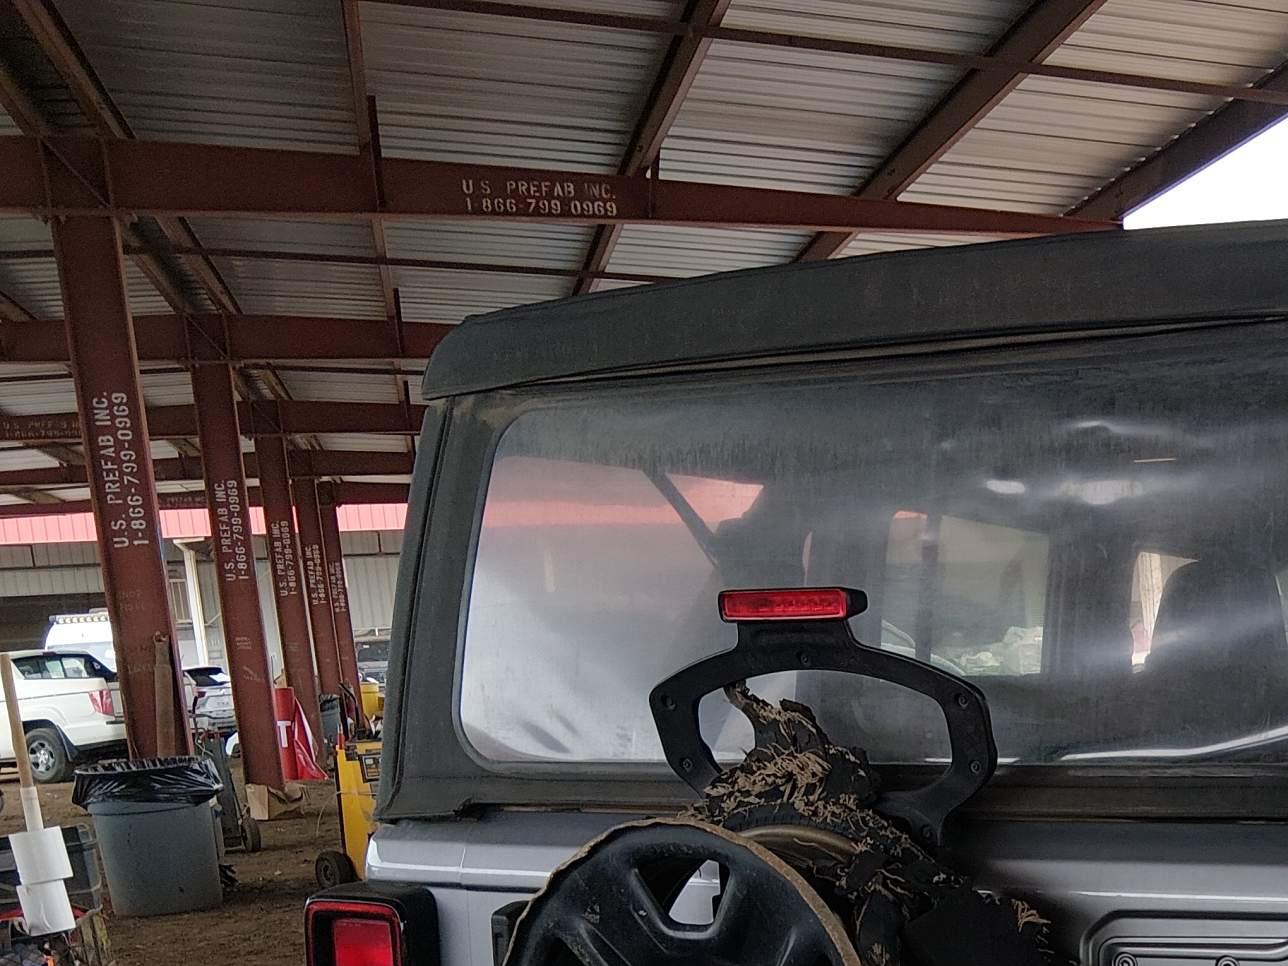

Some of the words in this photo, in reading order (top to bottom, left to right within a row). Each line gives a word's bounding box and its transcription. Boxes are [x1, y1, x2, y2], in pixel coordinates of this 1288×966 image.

[506, 180, 575, 198] PREFAB
[584, 183, 616, 199] INC.
[93, 391, 112, 426] INC.
[98, 435, 123, 504] PREFAB
[111, 392, 149, 546] 1-866-799-0969
[214, 479, 226, 502] INC.
[217, 507, 233, 553] PREFAB
[227, 480, 249, 579] 1-866-799-0969
